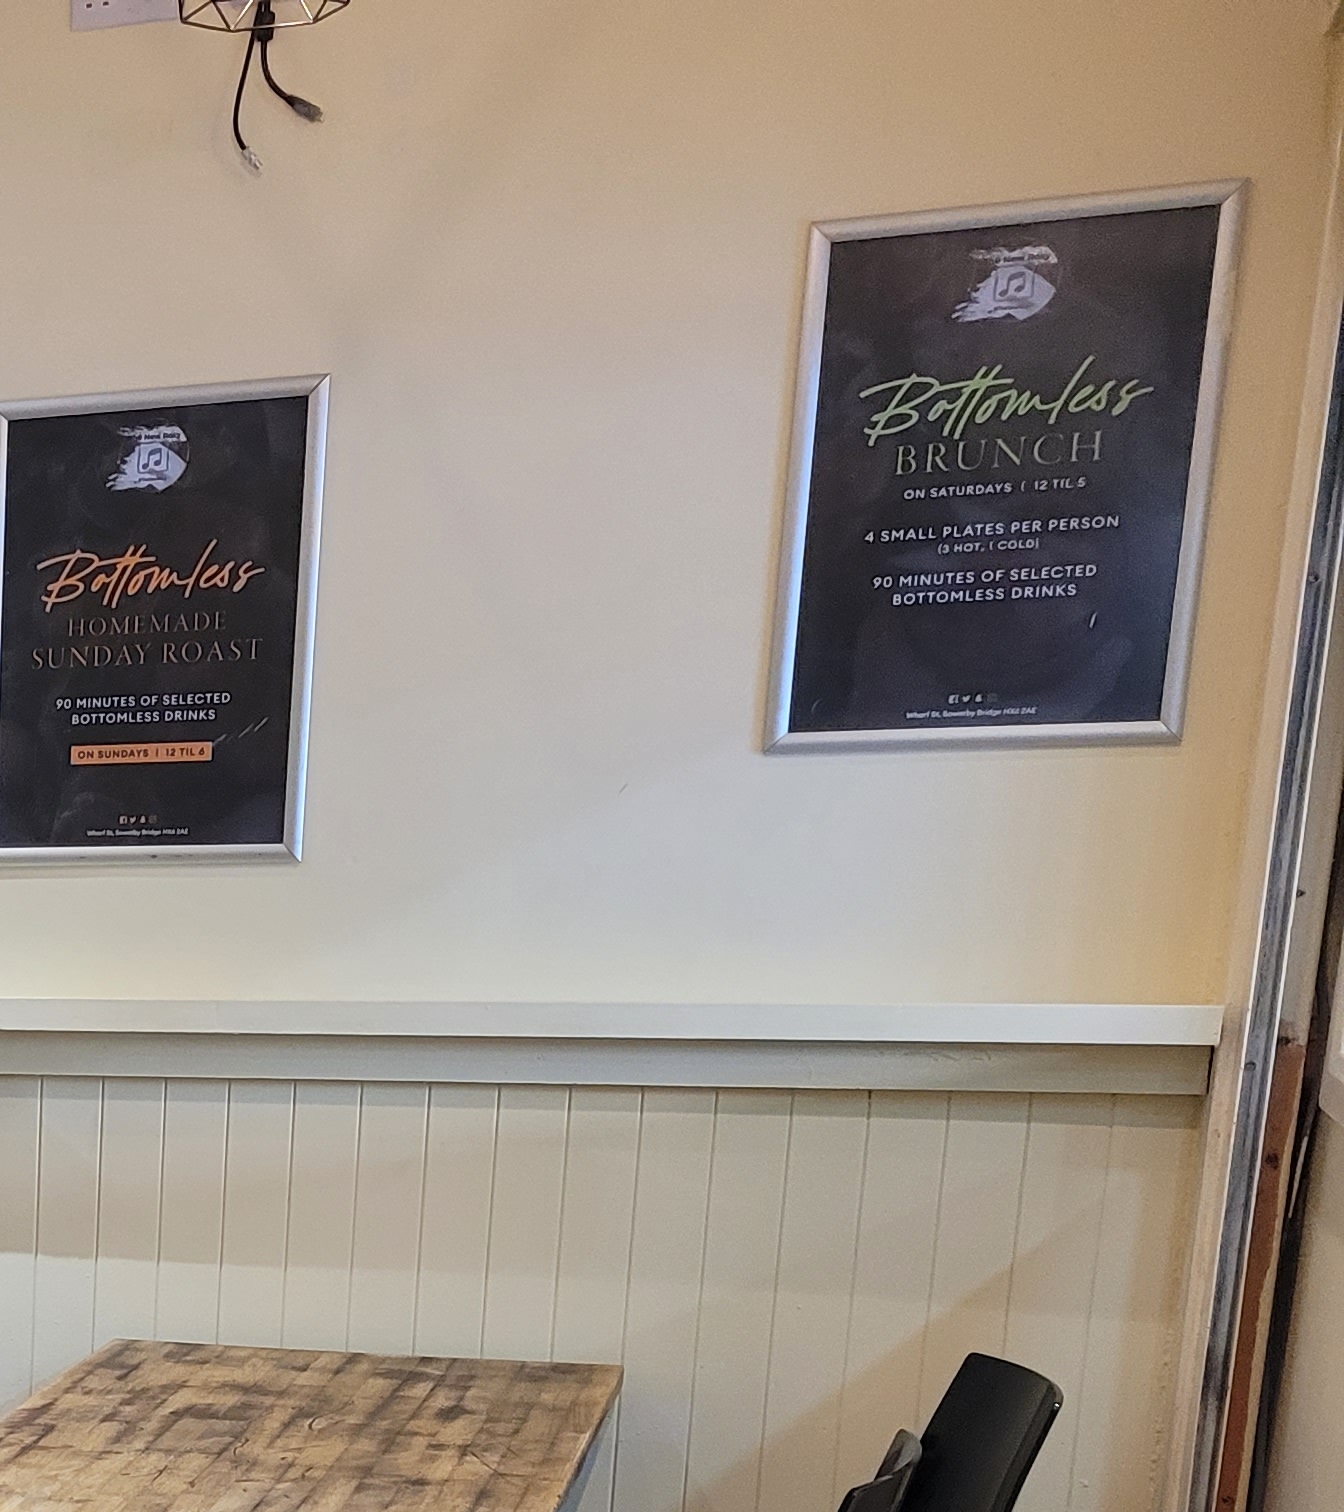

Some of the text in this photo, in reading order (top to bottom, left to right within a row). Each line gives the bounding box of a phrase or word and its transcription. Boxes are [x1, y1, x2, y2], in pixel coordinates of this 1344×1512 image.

[859, 355, 1155, 446] Bottomless
[895, 430, 1102, 475] BRUNCH
[904, 488, 925, 500] ON
[930, 482, 1012, 498] SATURDAYS
[1034, 480, 1049, 491] 12
[1053, 478, 1074, 489] TIL
[864, 515, 1120, 543] 4 SMALL PLATES PER PERSON
[36, 538, 265, 613] Bottomless
[872, 564, 1098, 589] 90 MINUTES OF SELECTED
[892, 583, 1078, 606] BOTTOMLESS DRINKS
[67, 611, 227, 637] HOMEMADE
[32, 638, 263, 670] SUNDAY ROAST
[55, 692, 231, 710] 90 MINUTES OF SELECTED
[71, 709, 216, 725] BOTTOMLESS DRINKS
[78, 750, 94, 760] ON
[98, 749, 149, 759] SUNDAYS
[166, 748, 176, 757] 12
[179, 747, 194, 756] TIL
[198, 746, 205, 756] 6
